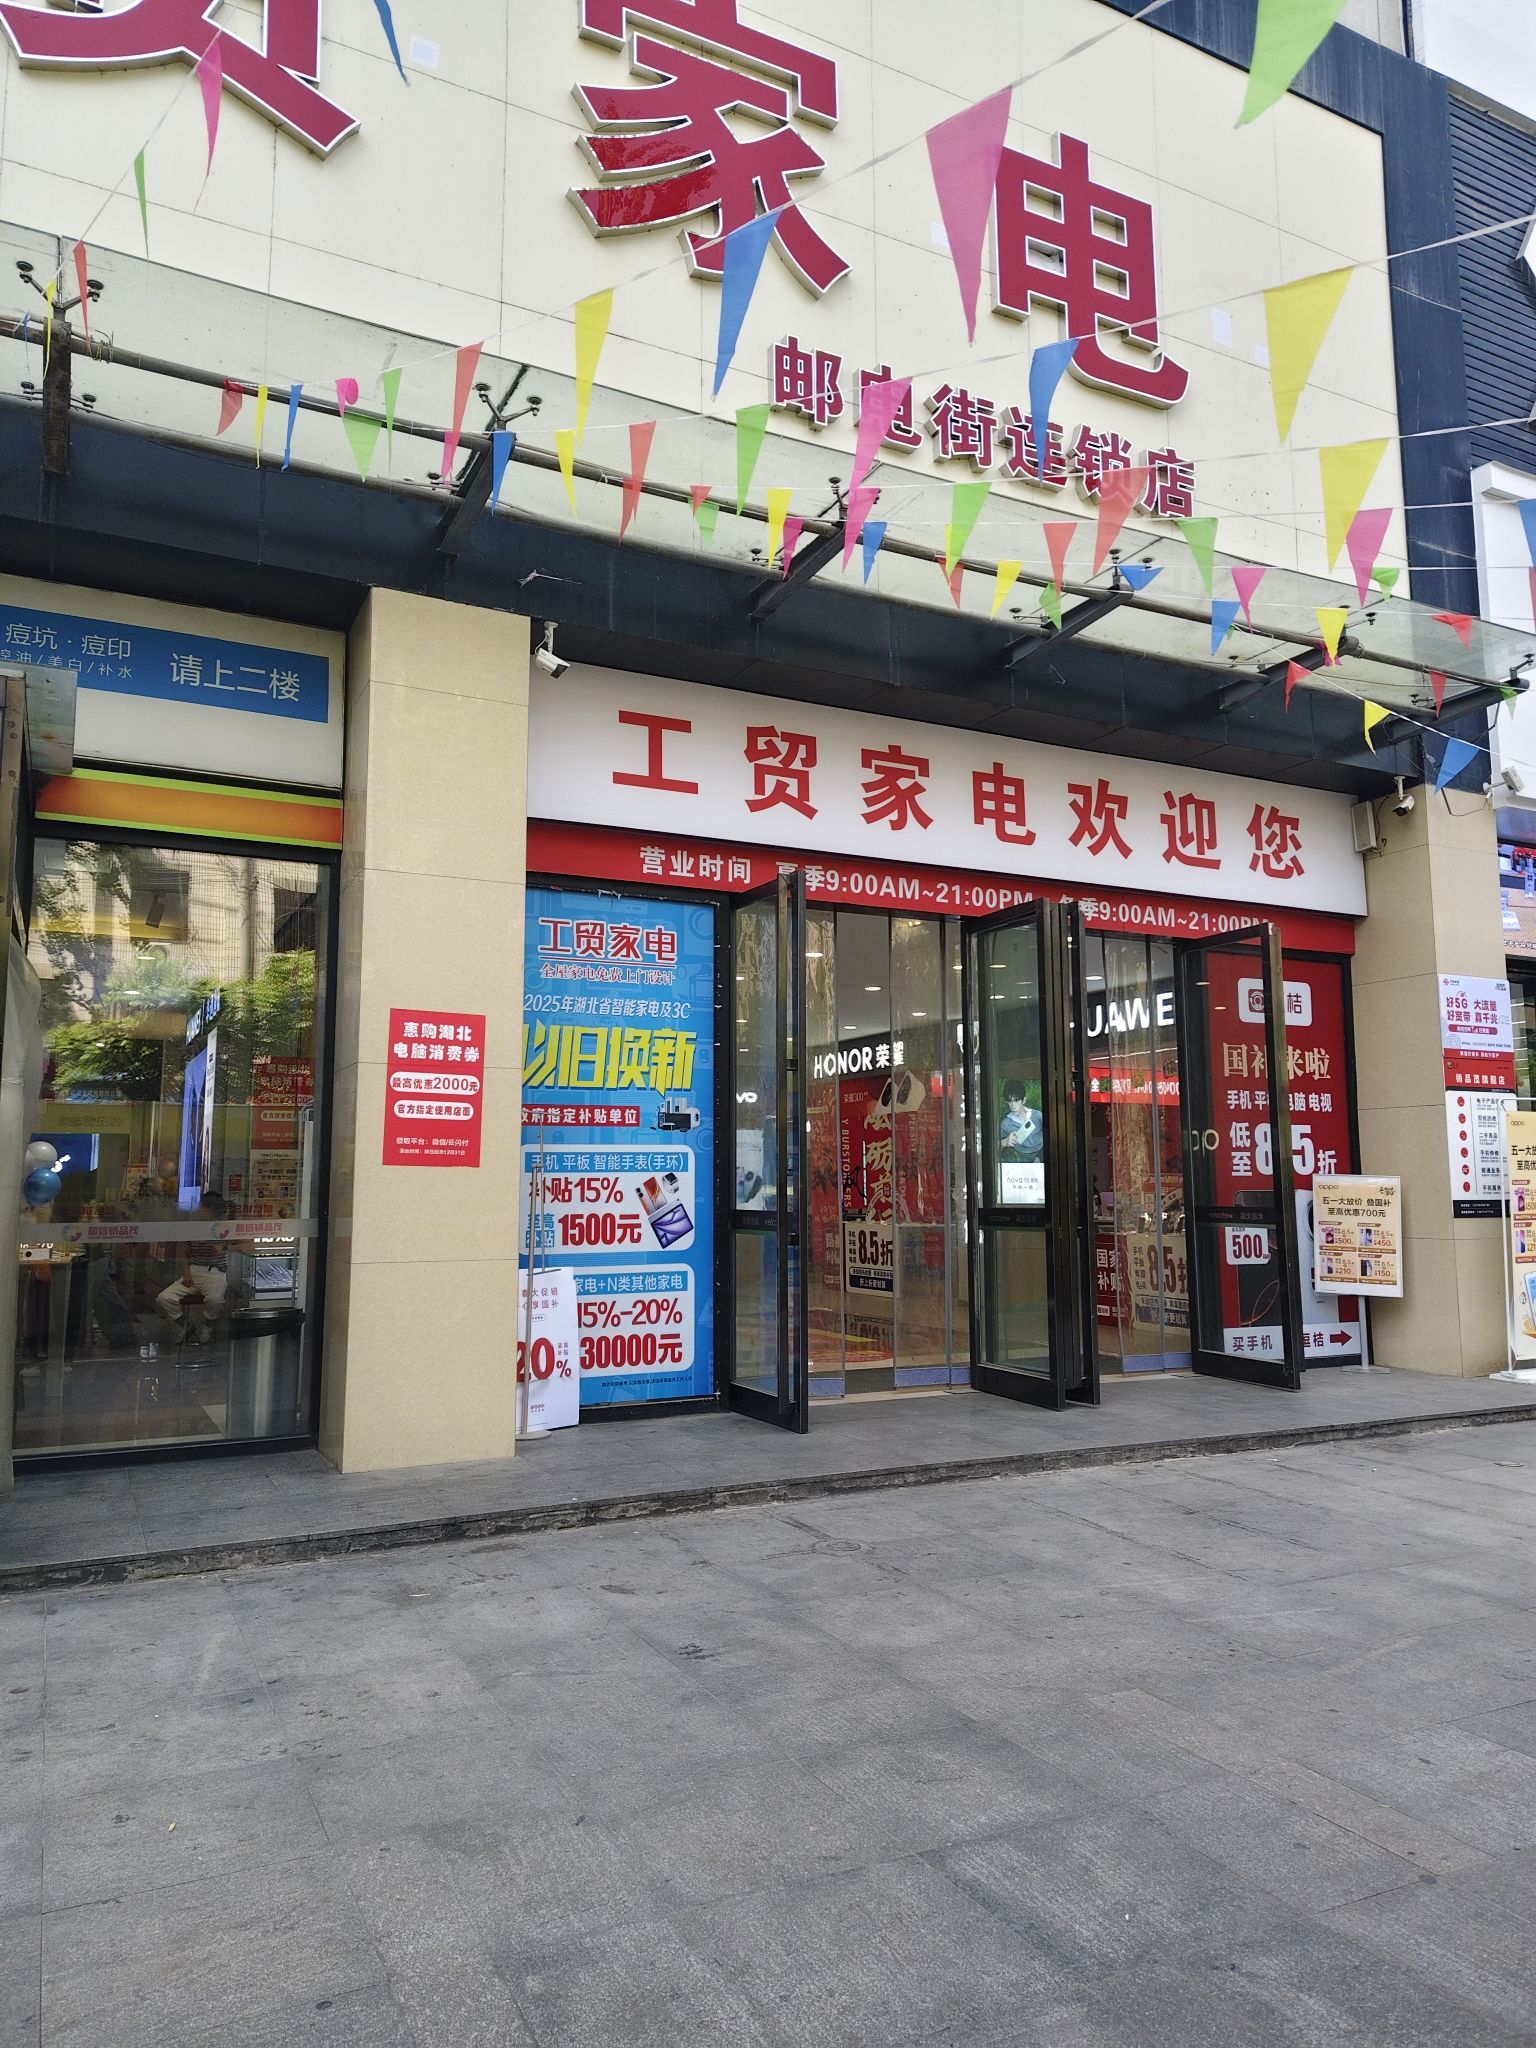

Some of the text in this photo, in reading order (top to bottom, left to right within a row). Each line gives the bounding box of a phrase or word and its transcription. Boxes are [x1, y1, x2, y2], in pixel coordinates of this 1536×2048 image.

[769, 334, 1196, 518] 邮电街连锁店
[170, 653, 301, 702] 请上二楼
[612, 709, 1305, 880] 工贸家电欢迎您
[639, 845, 752, 884] 营业时间
[538, 917, 678, 963] 工贸家电
[540, 963, 676, 986] 全屋家电免费上门设计
[523, 994, 691, 1019] 2025年湖北省智能家电及3C
[1287, 992, 1302, 1014] 桔
[1446, 996, 1498, 1012] 好5G 大流量
[1446, 1009, 1471, 1023] 好宽带
[403, 1022, 473, 1041] 惠购湖北
[393, 1042, 480, 1062] 电脑消费券
[521, 1018, 698, 1097] 以旧换新
[814, 1046, 873, 1079] HONOR
[392, 1077, 479, 1092] 最高优惠2000元
[396, 1104, 471, 1117] 官方指定使用店面
[1227, 1090, 1252, 1110] 手机
[1309, 1093, 1332, 1112] 电视
[563, 1154, 590, 1170] 平板
[593, 1153, 684, 1170] 智能手表(手环)
[1255, 1123, 1337, 1176] 85折
[1322, 1197, 1363, 1206] 五一大放价
[1328, 1208, 1387, 1218] 至高优惠700元
[558, 1212, 643, 1246] 1500元
[858, 1229, 893, 1267] 8.5折
[1232, 1234, 1263, 1259] 500
[578, 1298, 683, 1329] 15%-20%
[579, 1333, 683, 1371] 30000元
[1232, 1335, 1273, 1352] 买手机
